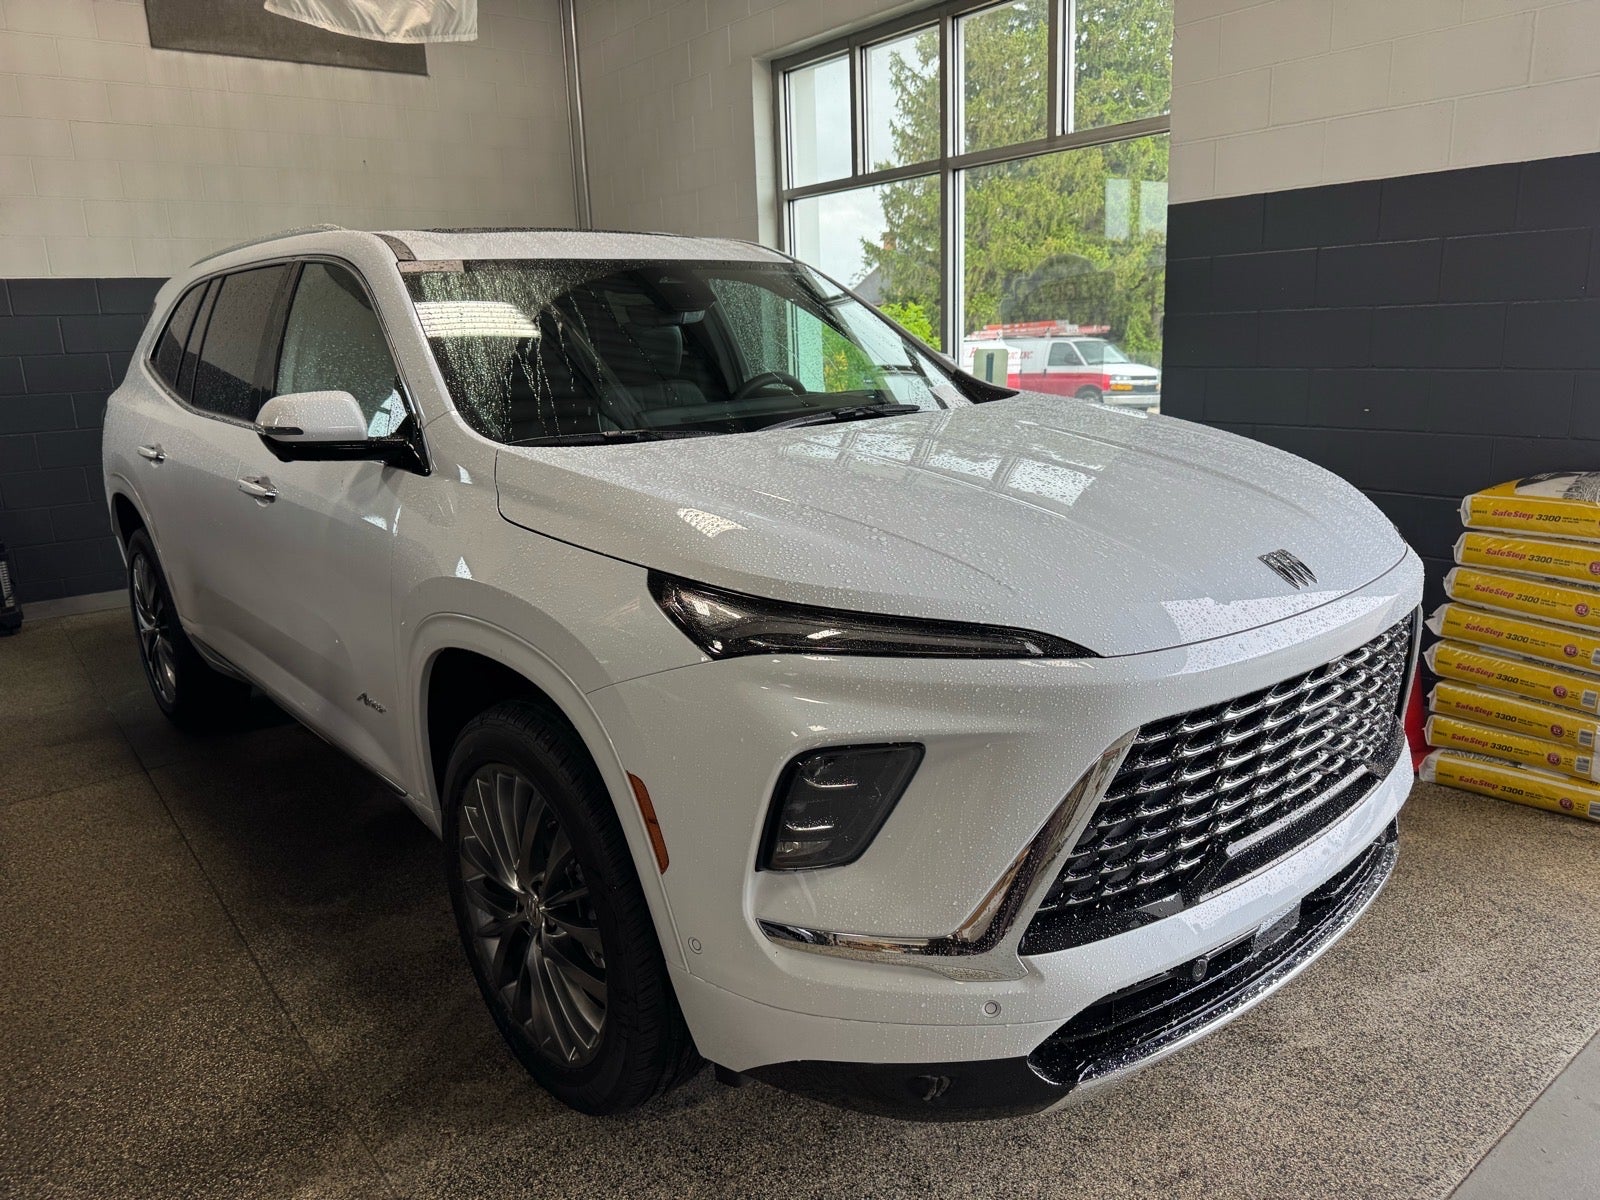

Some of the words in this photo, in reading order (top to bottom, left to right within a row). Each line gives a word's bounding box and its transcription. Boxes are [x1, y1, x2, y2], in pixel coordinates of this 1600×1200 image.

[1491, 509, 1534, 520] SafeStep
[1535, 514, 1561, 523] 3300
[1485, 548, 1526, 561] SafeStep
[1528, 554, 1553, 564] 3300
[1474, 584, 1514, 599] SafeStep
[1516, 593, 1540, 603] 3300
[1464, 623, 1504, 638] SafeStep
[1505, 633, 1529, 643] 3300
[1455, 662, 1495, 678] SafeStep
[1496, 673, 1519, 684] 3300
[1455, 702, 1493, 717] SafeStep
[1494, 712, 1517, 723] 3300
[1451, 733, 1489, 748] SafeStep
[1490, 742, 1513, 753] 3300
[1458, 775, 1499, 790] SafeStep
[1500, 785, 1525, 796] 3300
